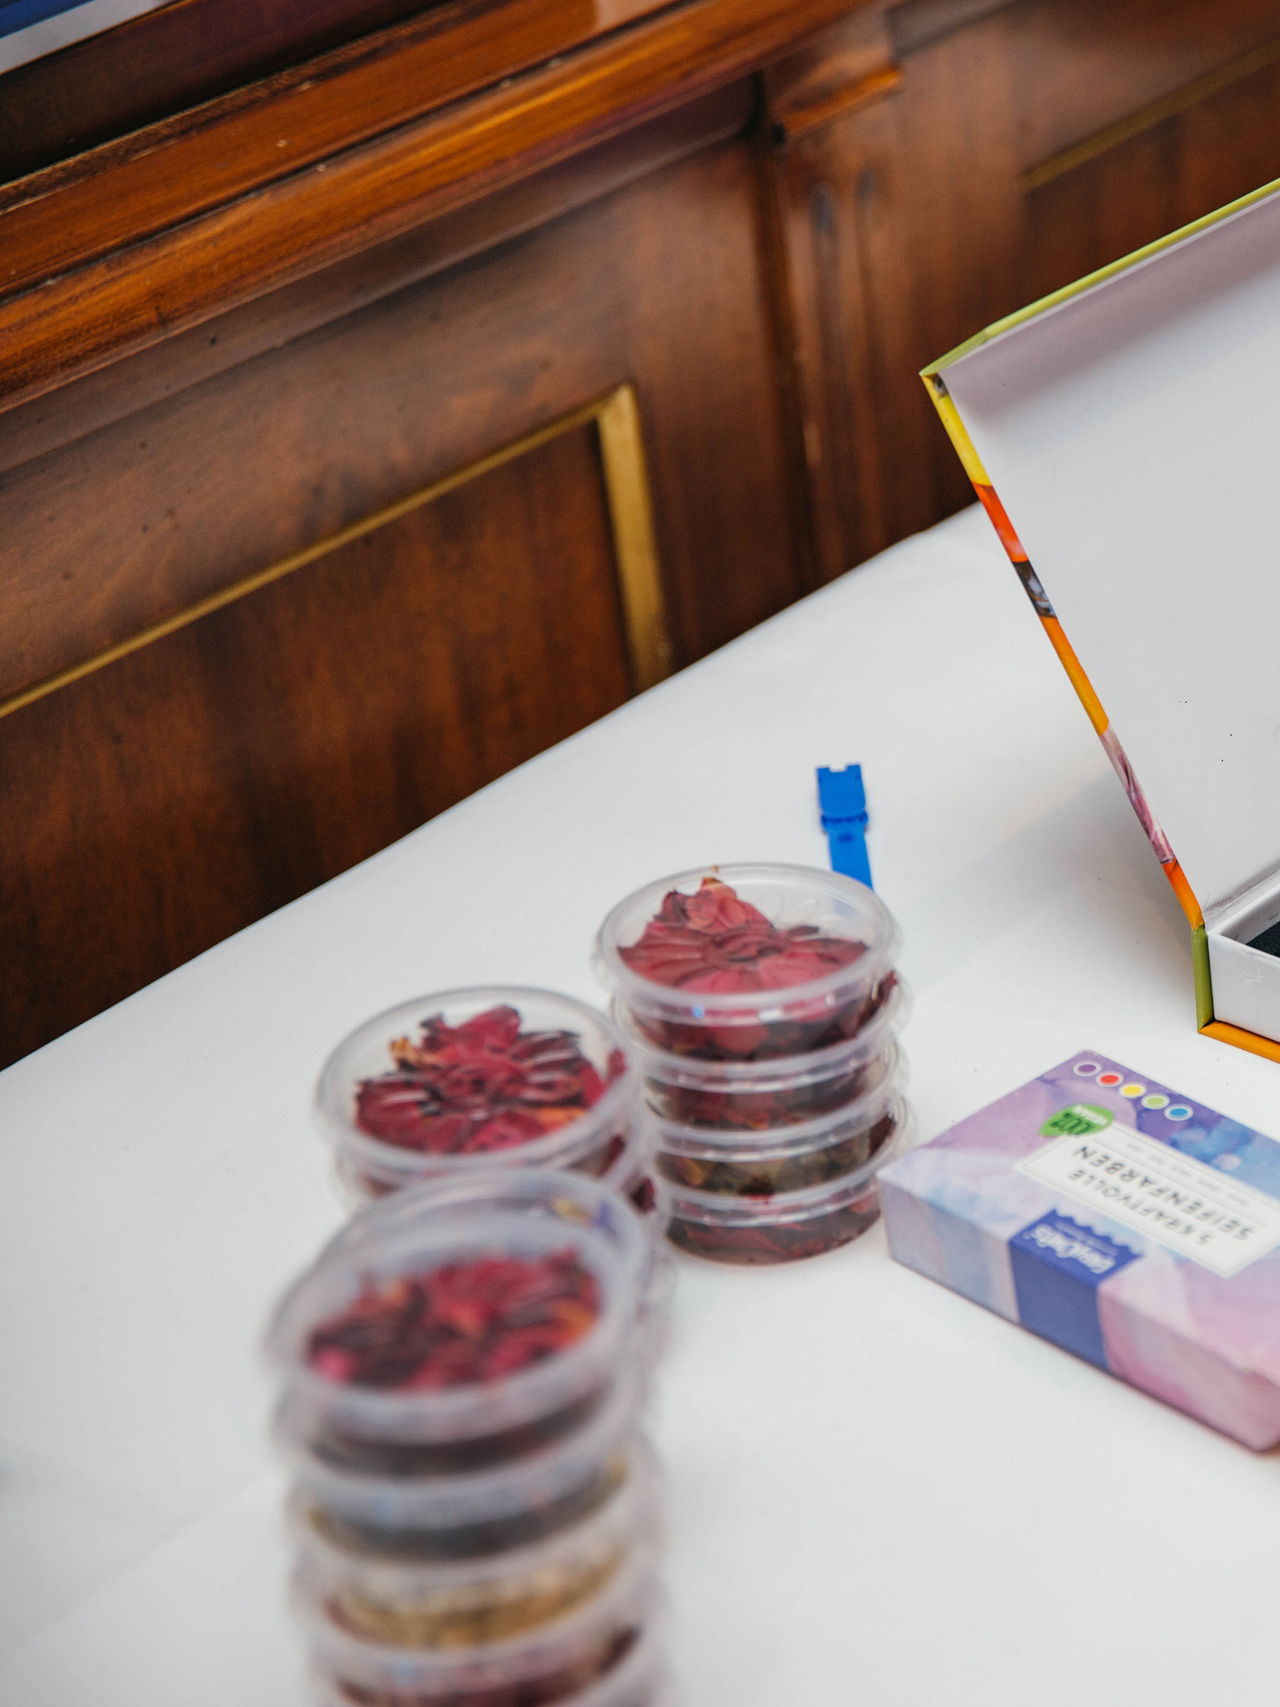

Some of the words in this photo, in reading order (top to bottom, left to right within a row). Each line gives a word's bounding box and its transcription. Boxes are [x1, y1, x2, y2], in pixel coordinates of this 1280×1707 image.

[1068, 1169, 1195, 1237] KRAFTVOLLE
[1072, 1146, 1257, 1240] SEIFENFARBEN
[1196, 1233, 1213, 1246] 5
